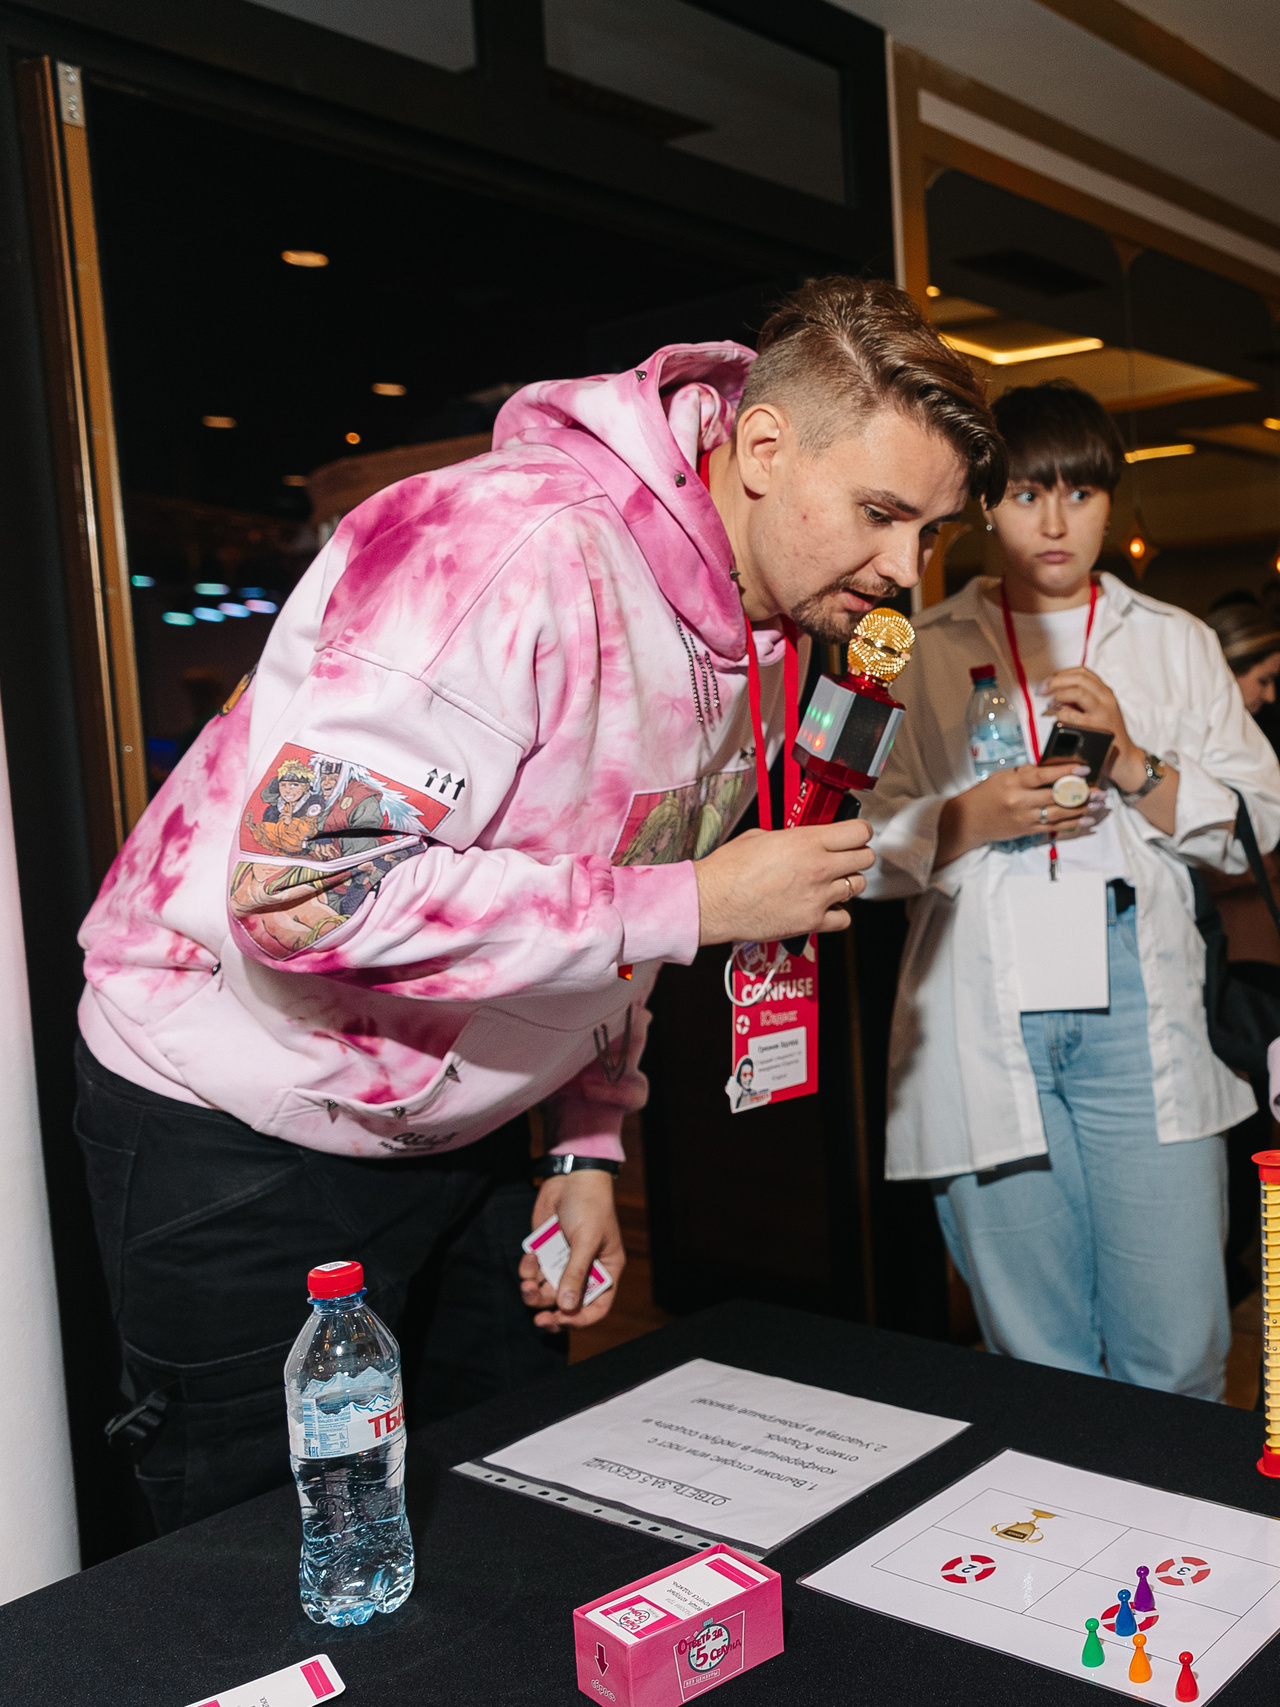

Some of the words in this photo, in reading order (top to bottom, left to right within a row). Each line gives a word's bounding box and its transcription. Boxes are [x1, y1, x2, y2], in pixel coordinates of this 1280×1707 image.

[657, 1441, 687, 1451] пост
[698, 1433, 742, 1448] любую
[815, 1428, 874, 1450] Участвуй
[685, 1449, 711, 1458] или
[750, 1448, 837, 1474] конференции
[815, 1446, 859, 1462] отметь
[710, 1455, 753, 1470] сторис
[651, 1477, 671, 1489] ЗА
[754, 1468, 807, 1488] Выложи
[673, 1483, 727, 1506] ОТВЕТЬ
[961, 1563, 978, 1574] 2
[1176, 1566, 1191, 1576] 3
[696, 1646, 708, 1668] 5
[684, 1679, 696, 1688] БЕЗ
